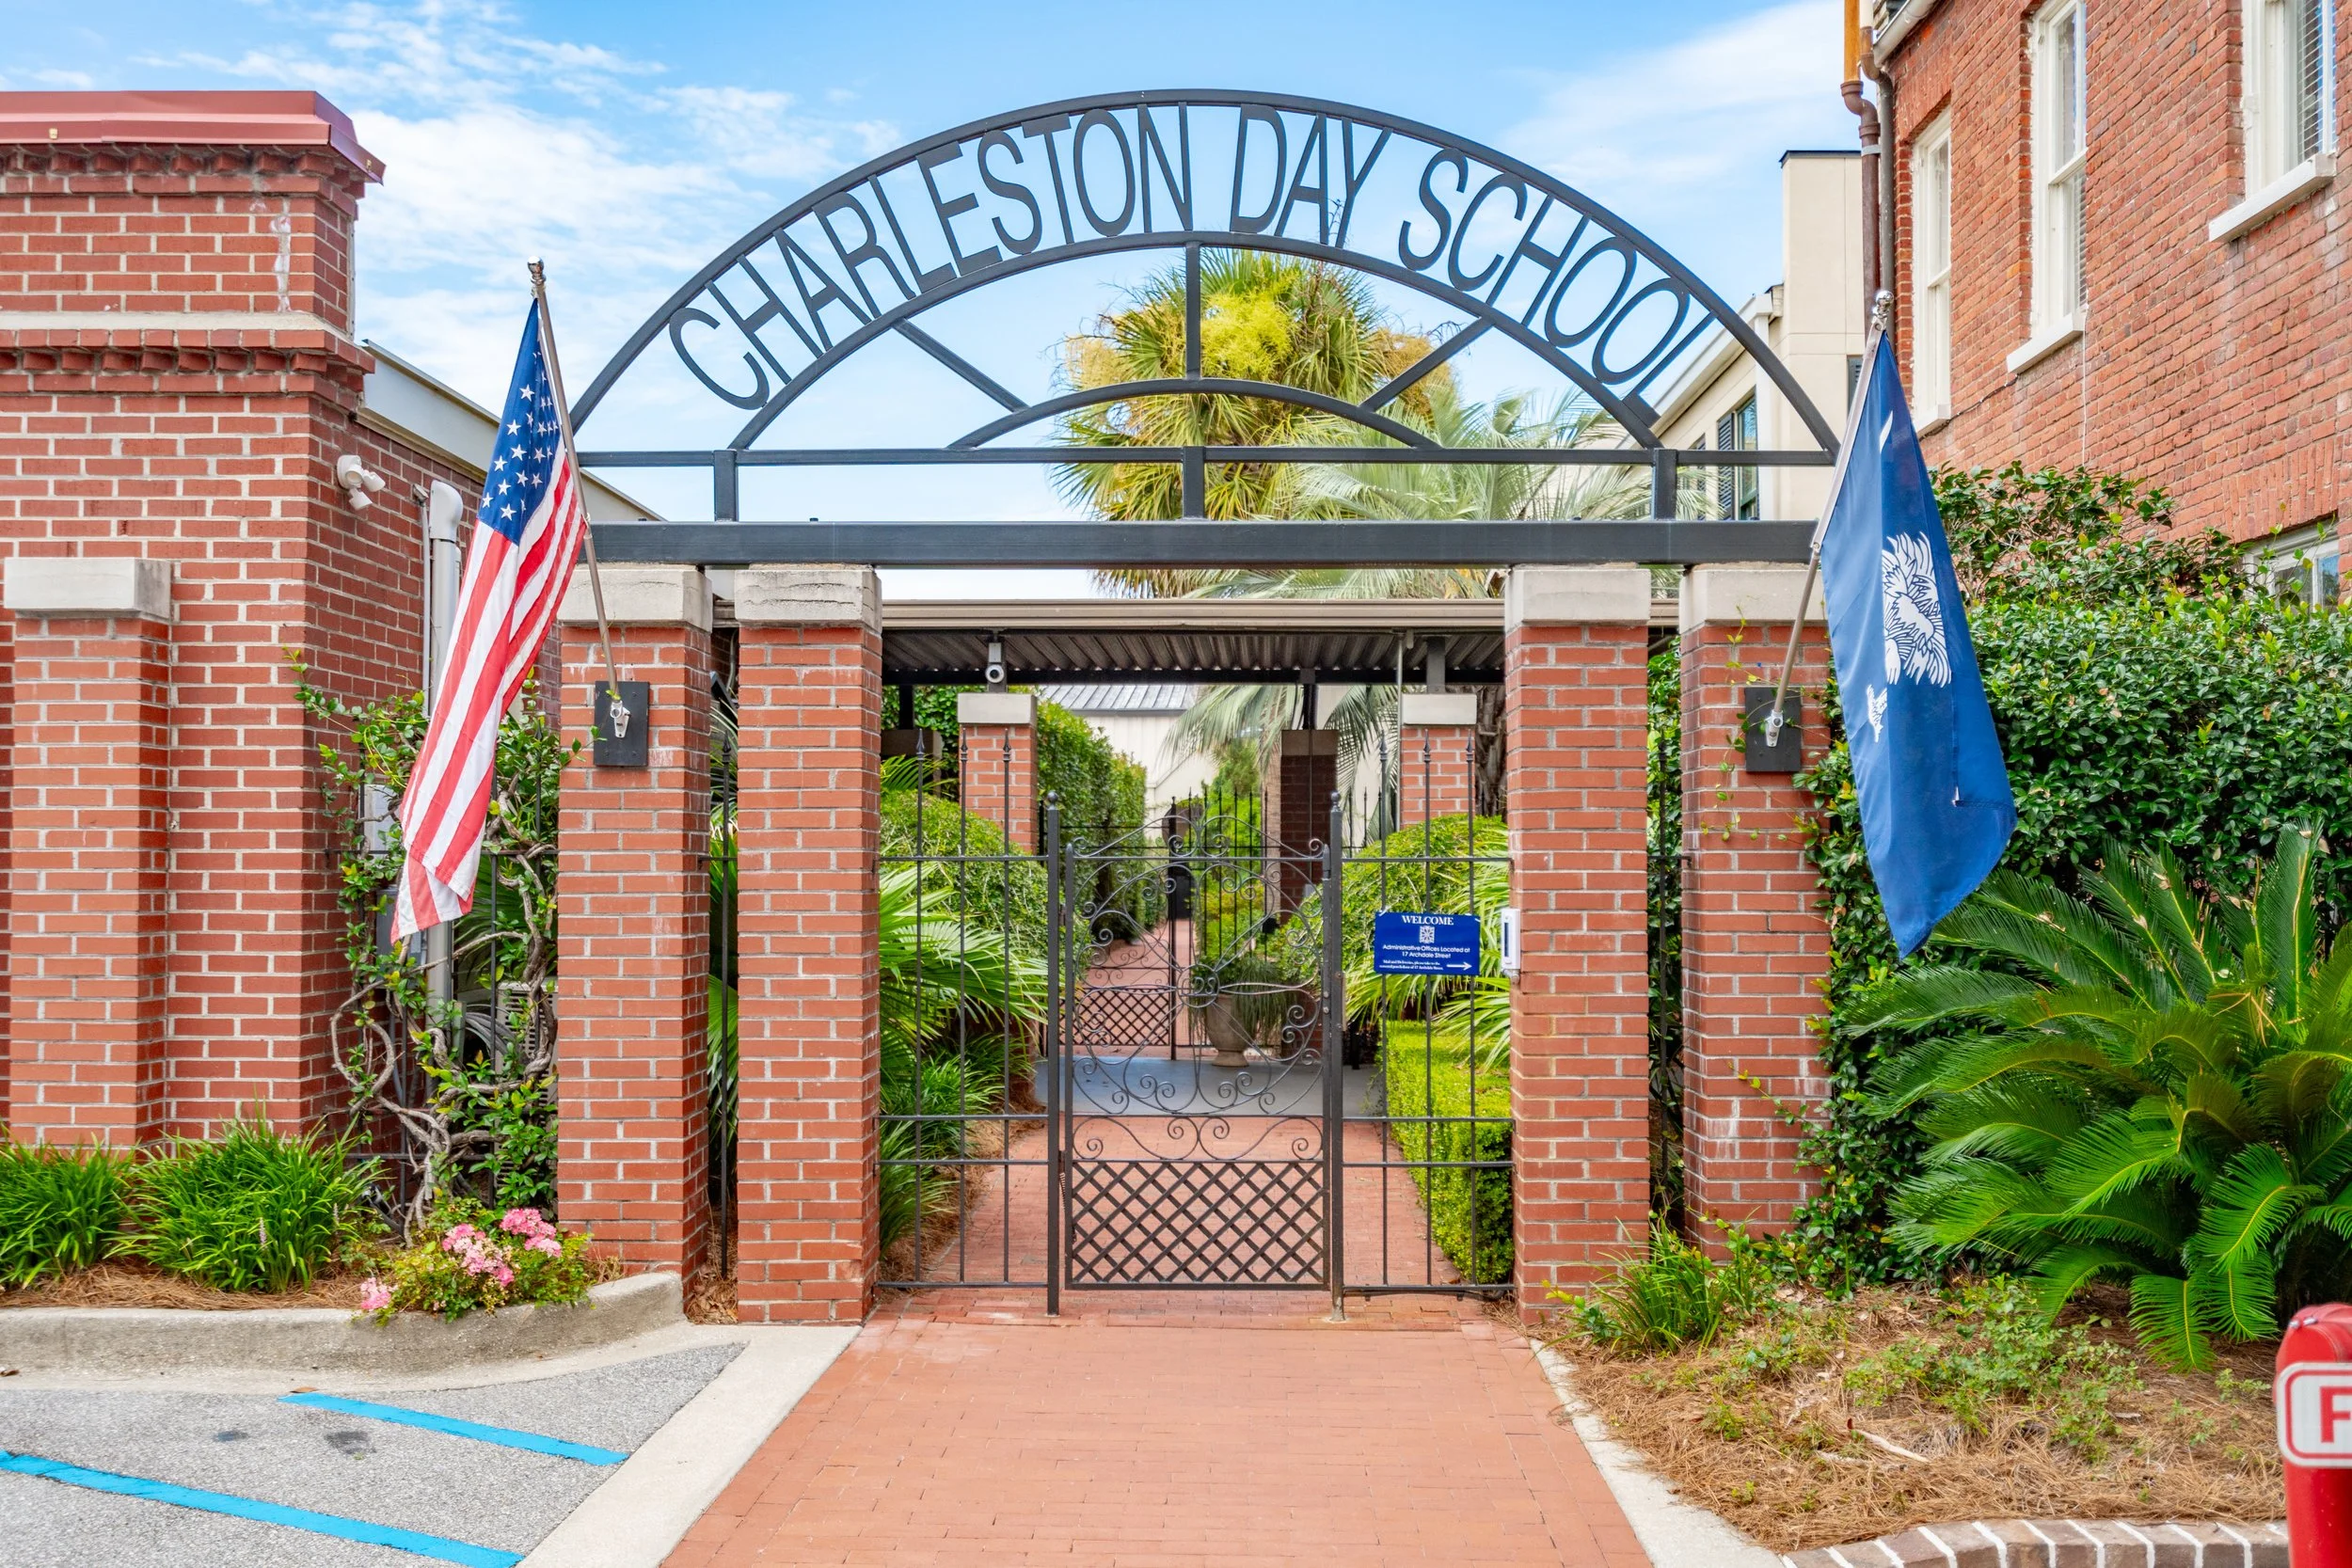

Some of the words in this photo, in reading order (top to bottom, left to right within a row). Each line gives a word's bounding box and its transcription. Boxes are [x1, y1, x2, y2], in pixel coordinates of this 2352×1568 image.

[668, 102, 1193, 410] CHARLESTON
[1229, 103, 1393, 248] DAY
[1398, 147, 1719, 427] SCHOOL
[1402, 915, 1454, 926] WELCOME
